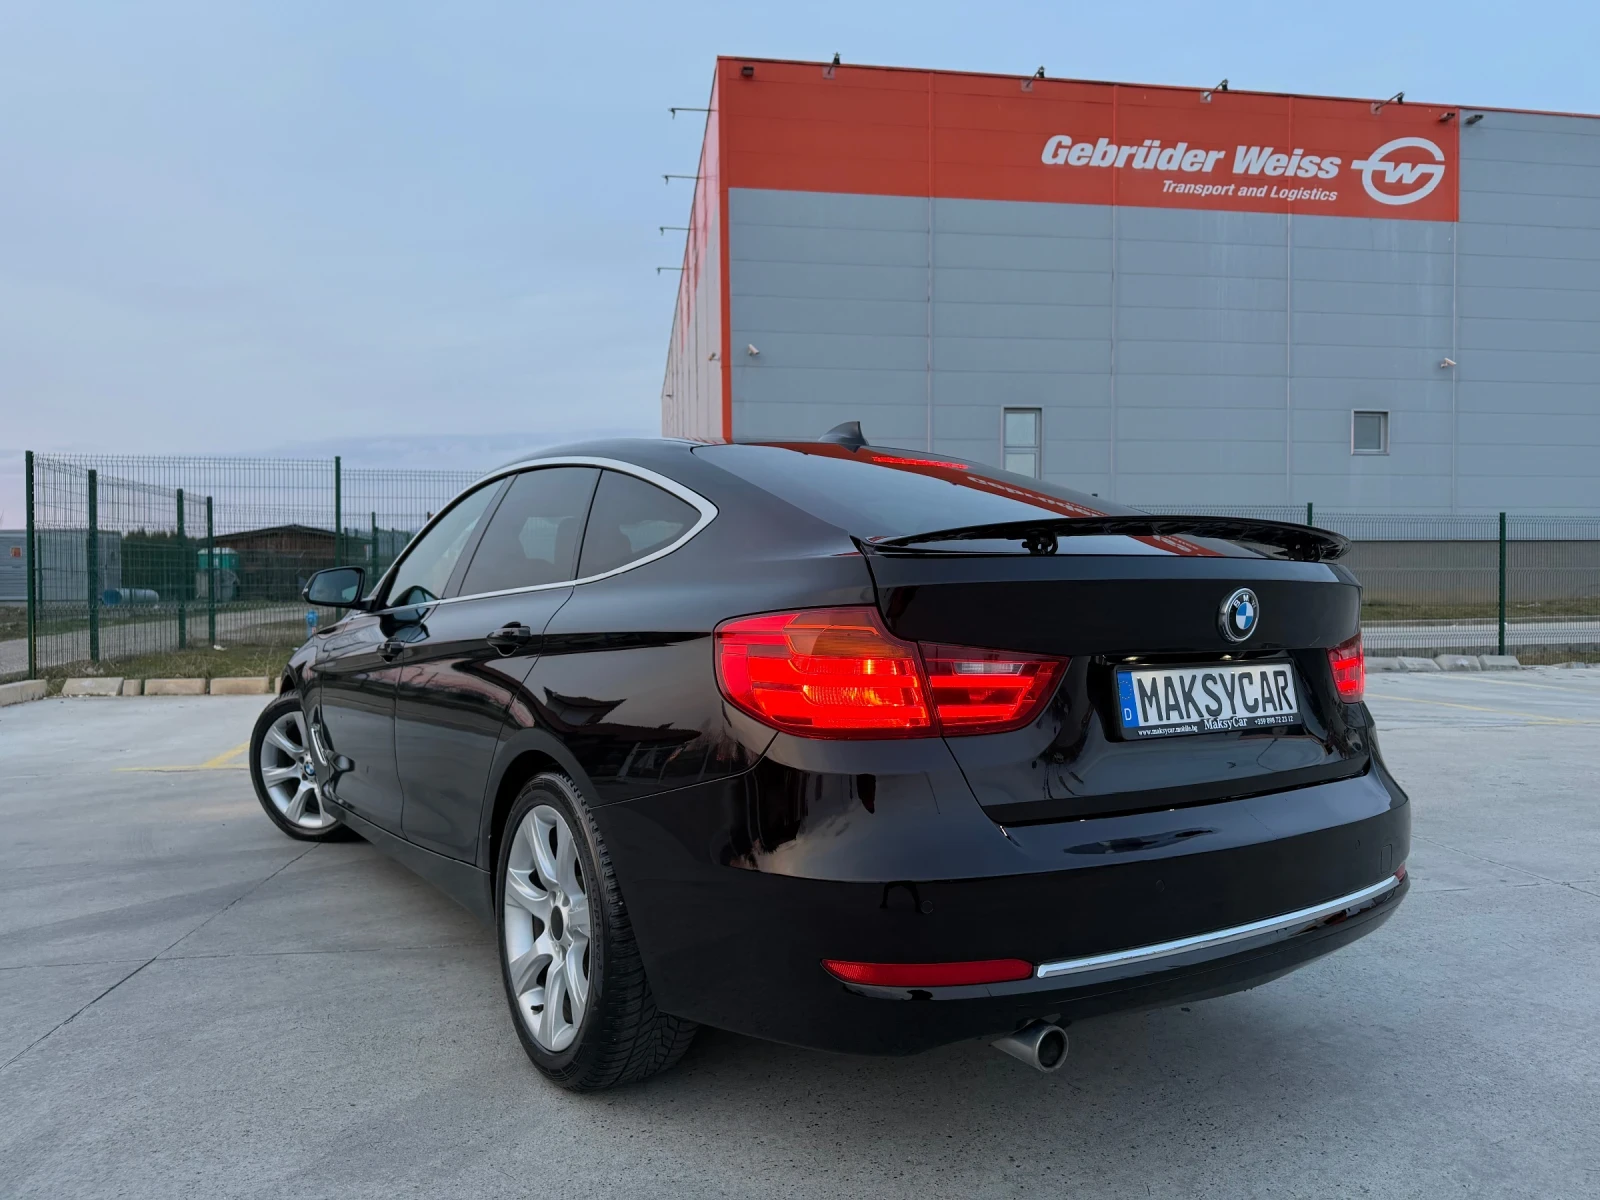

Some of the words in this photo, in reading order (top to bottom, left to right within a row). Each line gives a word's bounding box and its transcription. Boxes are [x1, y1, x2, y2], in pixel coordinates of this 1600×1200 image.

[1040, 133, 1225, 174] Gebrüder
[1232, 144, 1341, 180] Weiss
[1162, 179, 1233, 199] Transport
[1237, 183, 1266, 198] and
[1270, 185, 1338, 203] Logistics
[1137, 670, 1293, 723] MAKSYCAR
[1123, 707, 1133, 721] D
[1204, 716, 1248, 731] MaksyCar
